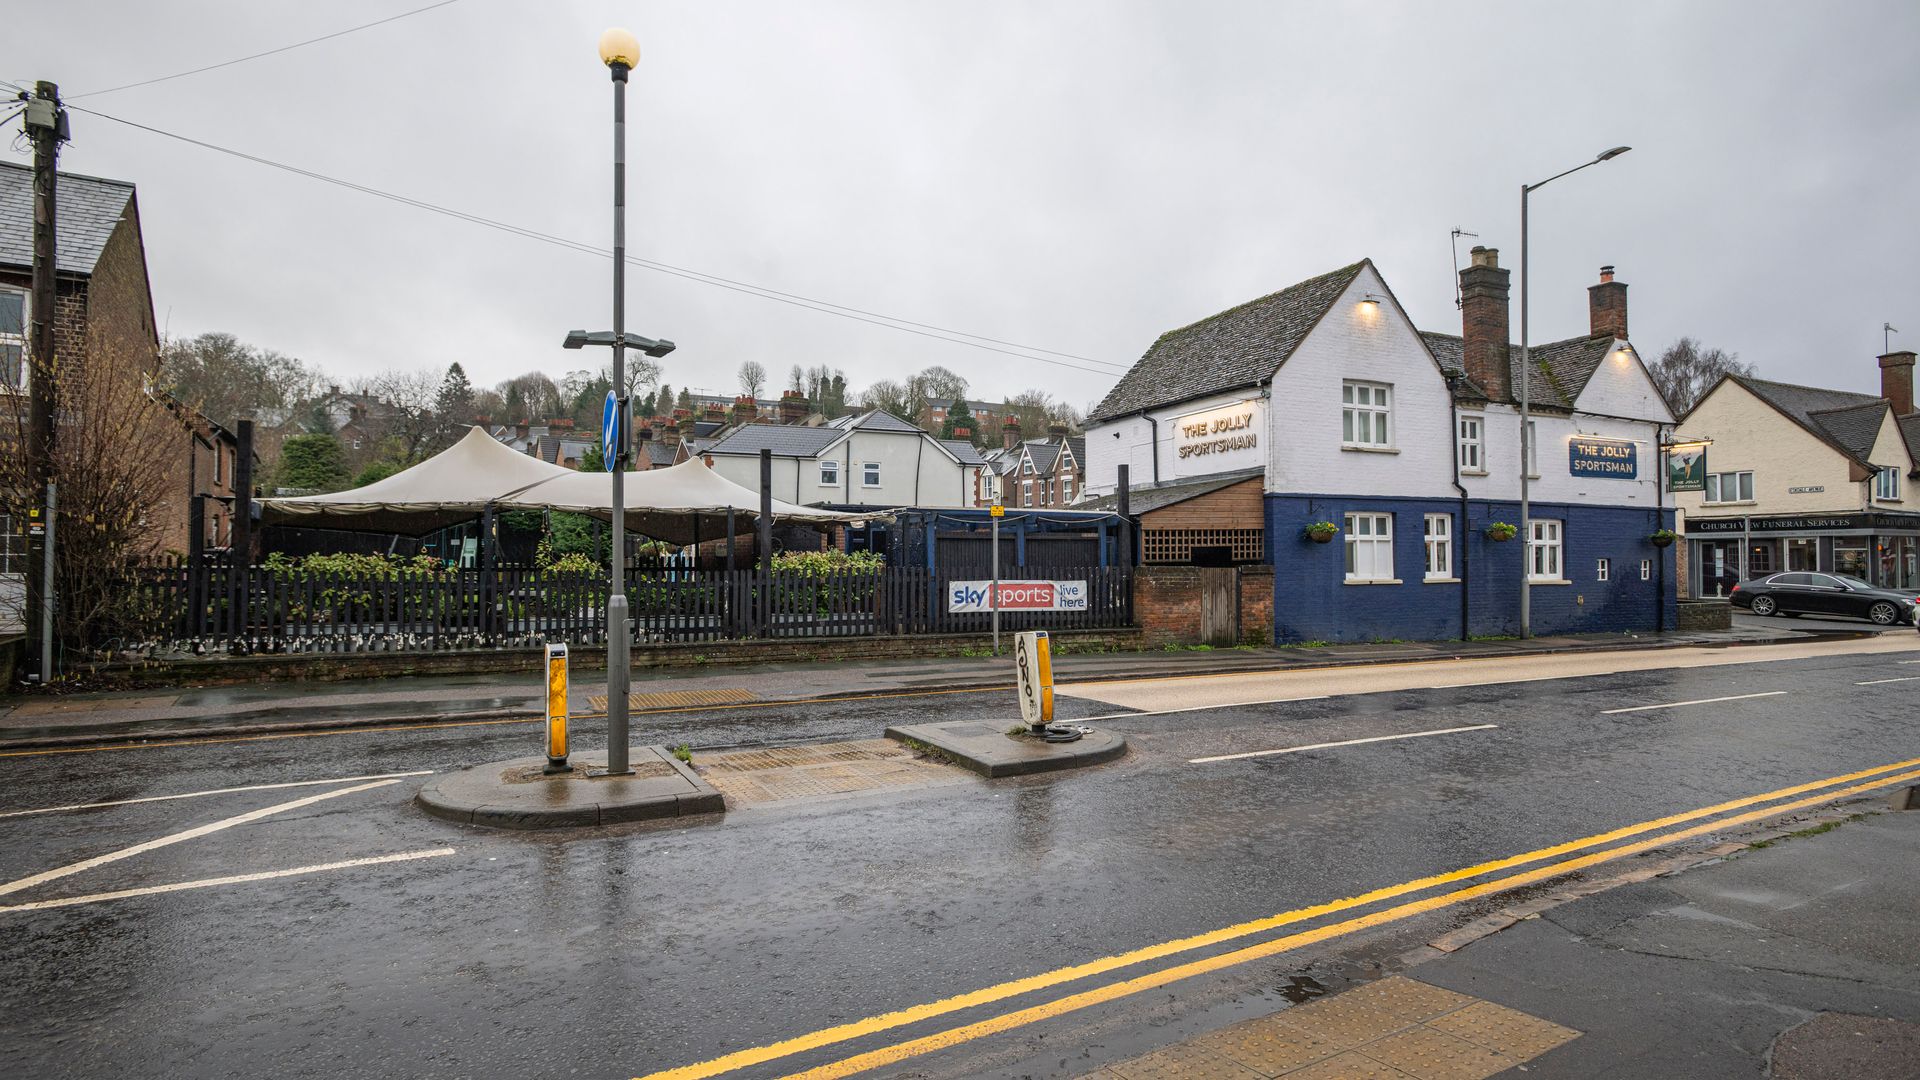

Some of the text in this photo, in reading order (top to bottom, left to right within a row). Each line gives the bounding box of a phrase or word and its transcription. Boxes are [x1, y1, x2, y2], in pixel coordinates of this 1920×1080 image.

[1183, 413, 1252, 438] THE JOLLY
[1179, 433, 1257, 458] SPORTSMAN
[1578, 444, 1630, 458] THE JOLLY
[1574, 459, 1633, 473] SPORTSMAN
[1700, 522, 1737, 530] CHURCH
[1762, 520, 1805, 528] FUNERAL
[1807, 519, 1850, 527] SERVICES
[954, 586, 988, 607] sky
[1060, 584, 1078, 596] live
[1060, 597, 1084, 608] here
